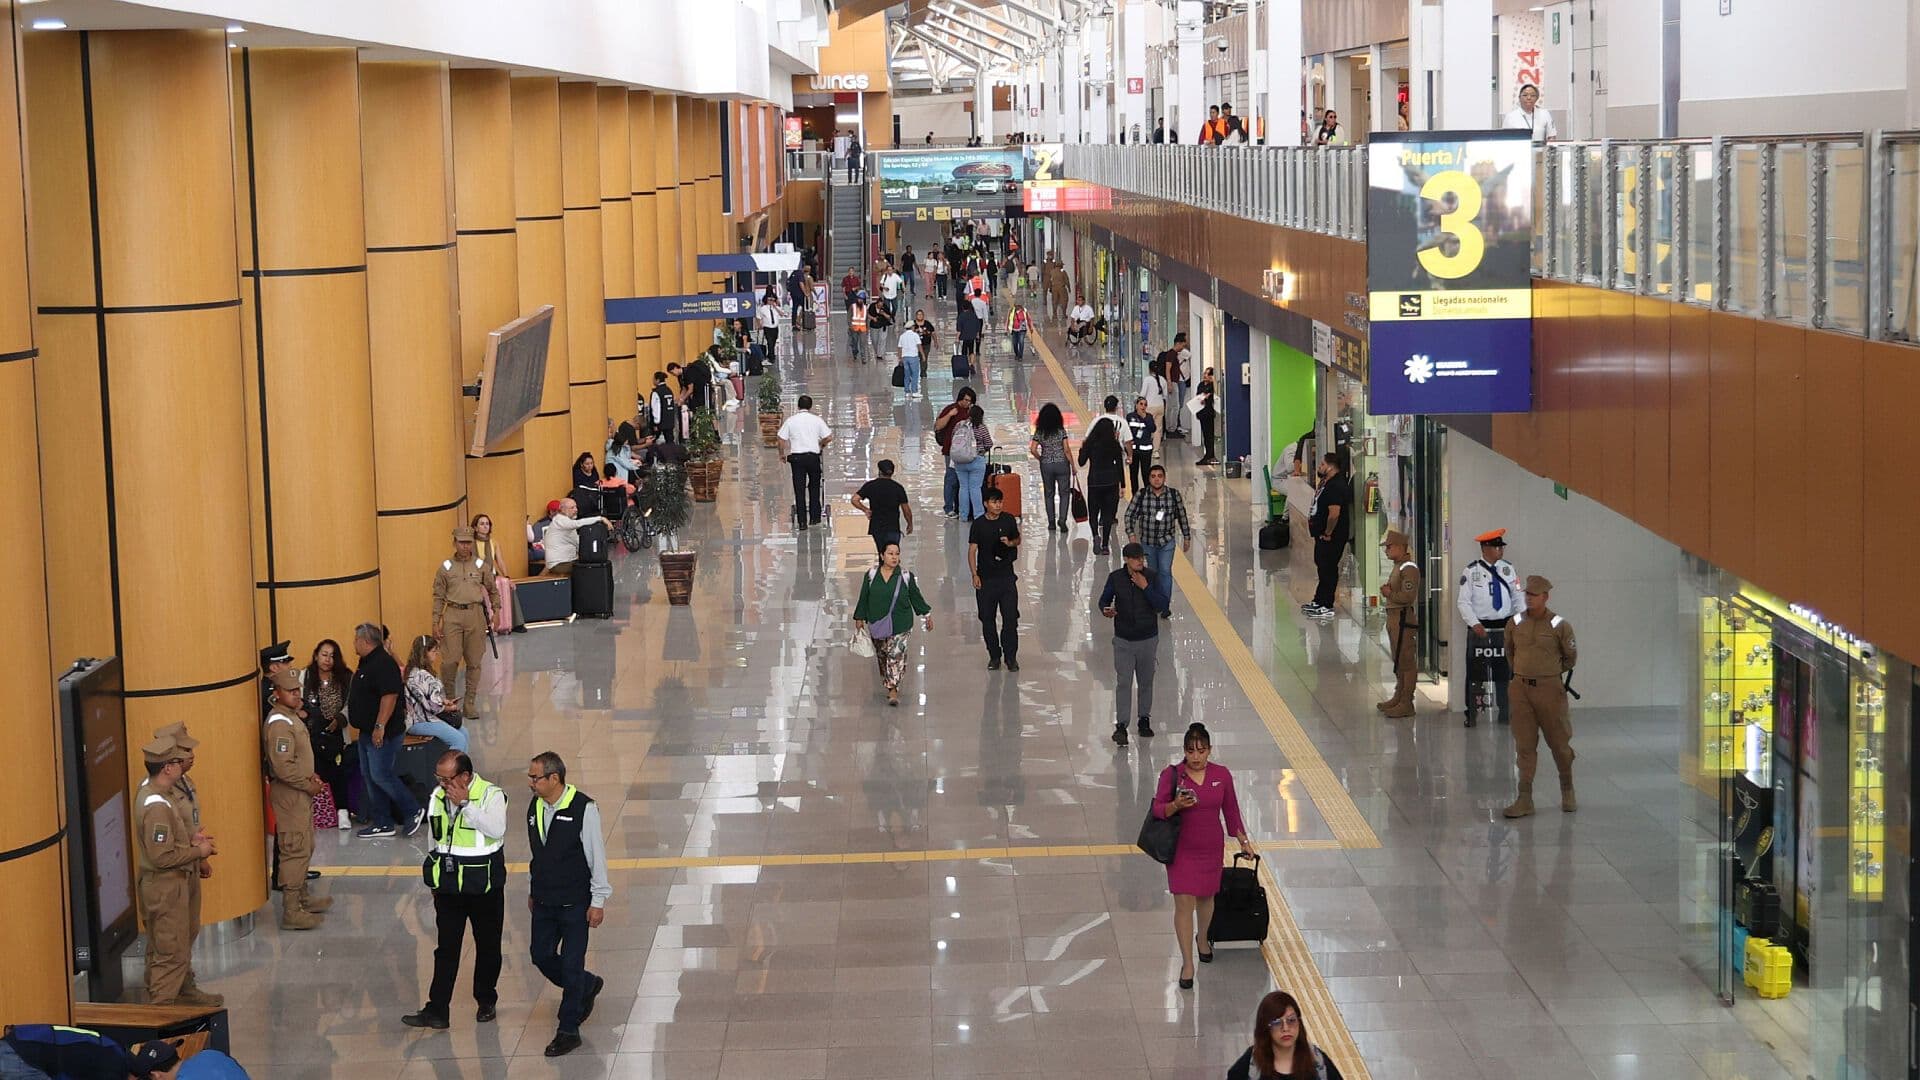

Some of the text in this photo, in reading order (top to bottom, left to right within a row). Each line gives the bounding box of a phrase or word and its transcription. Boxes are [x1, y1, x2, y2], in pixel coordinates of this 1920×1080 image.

[1035, 151, 1052, 180] 2
[1401, 149, 1452, 166] Puerta
[1416, 170, 1485, 279] 3
[1432, 295, 1508, 306] Llegadas nacionales
